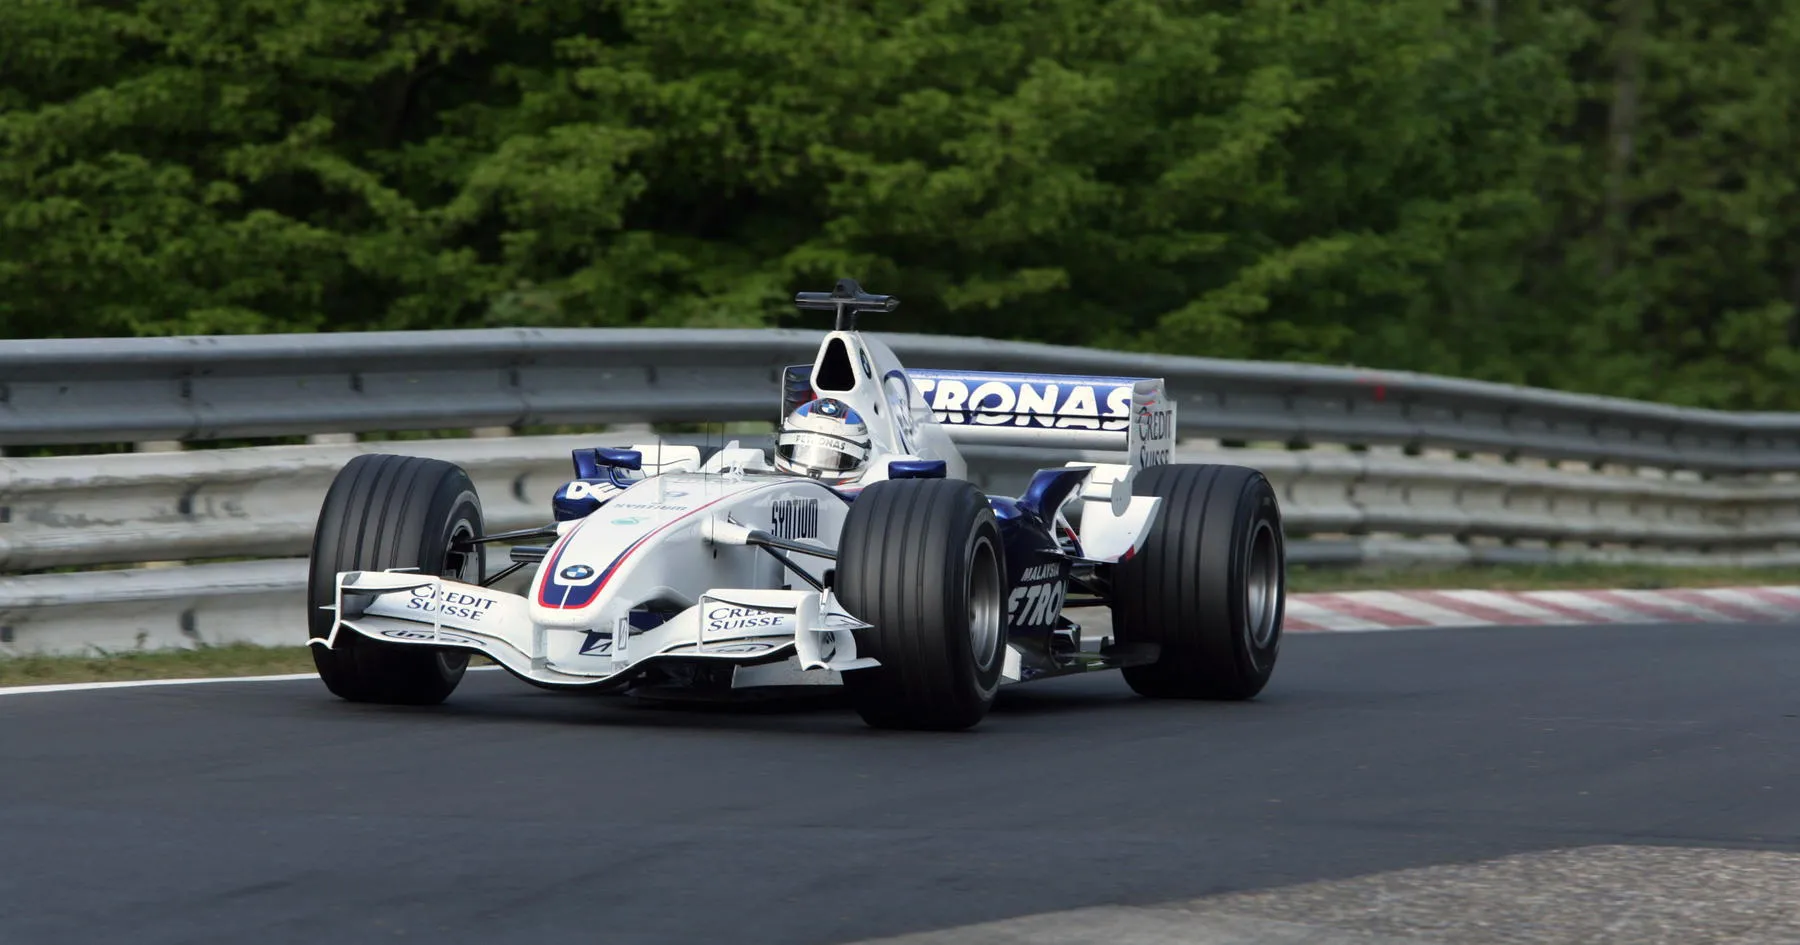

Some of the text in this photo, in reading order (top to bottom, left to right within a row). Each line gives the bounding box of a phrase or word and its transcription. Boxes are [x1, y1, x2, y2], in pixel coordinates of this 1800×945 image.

[1138, 406, 1172, 441] CREDIT
[771, 499, 818, 540] SYNTIUM
[407, 598, 484, 621] SUISSE
[410, 585, 497, 610] CREDIT
[1007, 580, 1066, 626] ETRO
[707, 616, 784, 632] SUISSE
